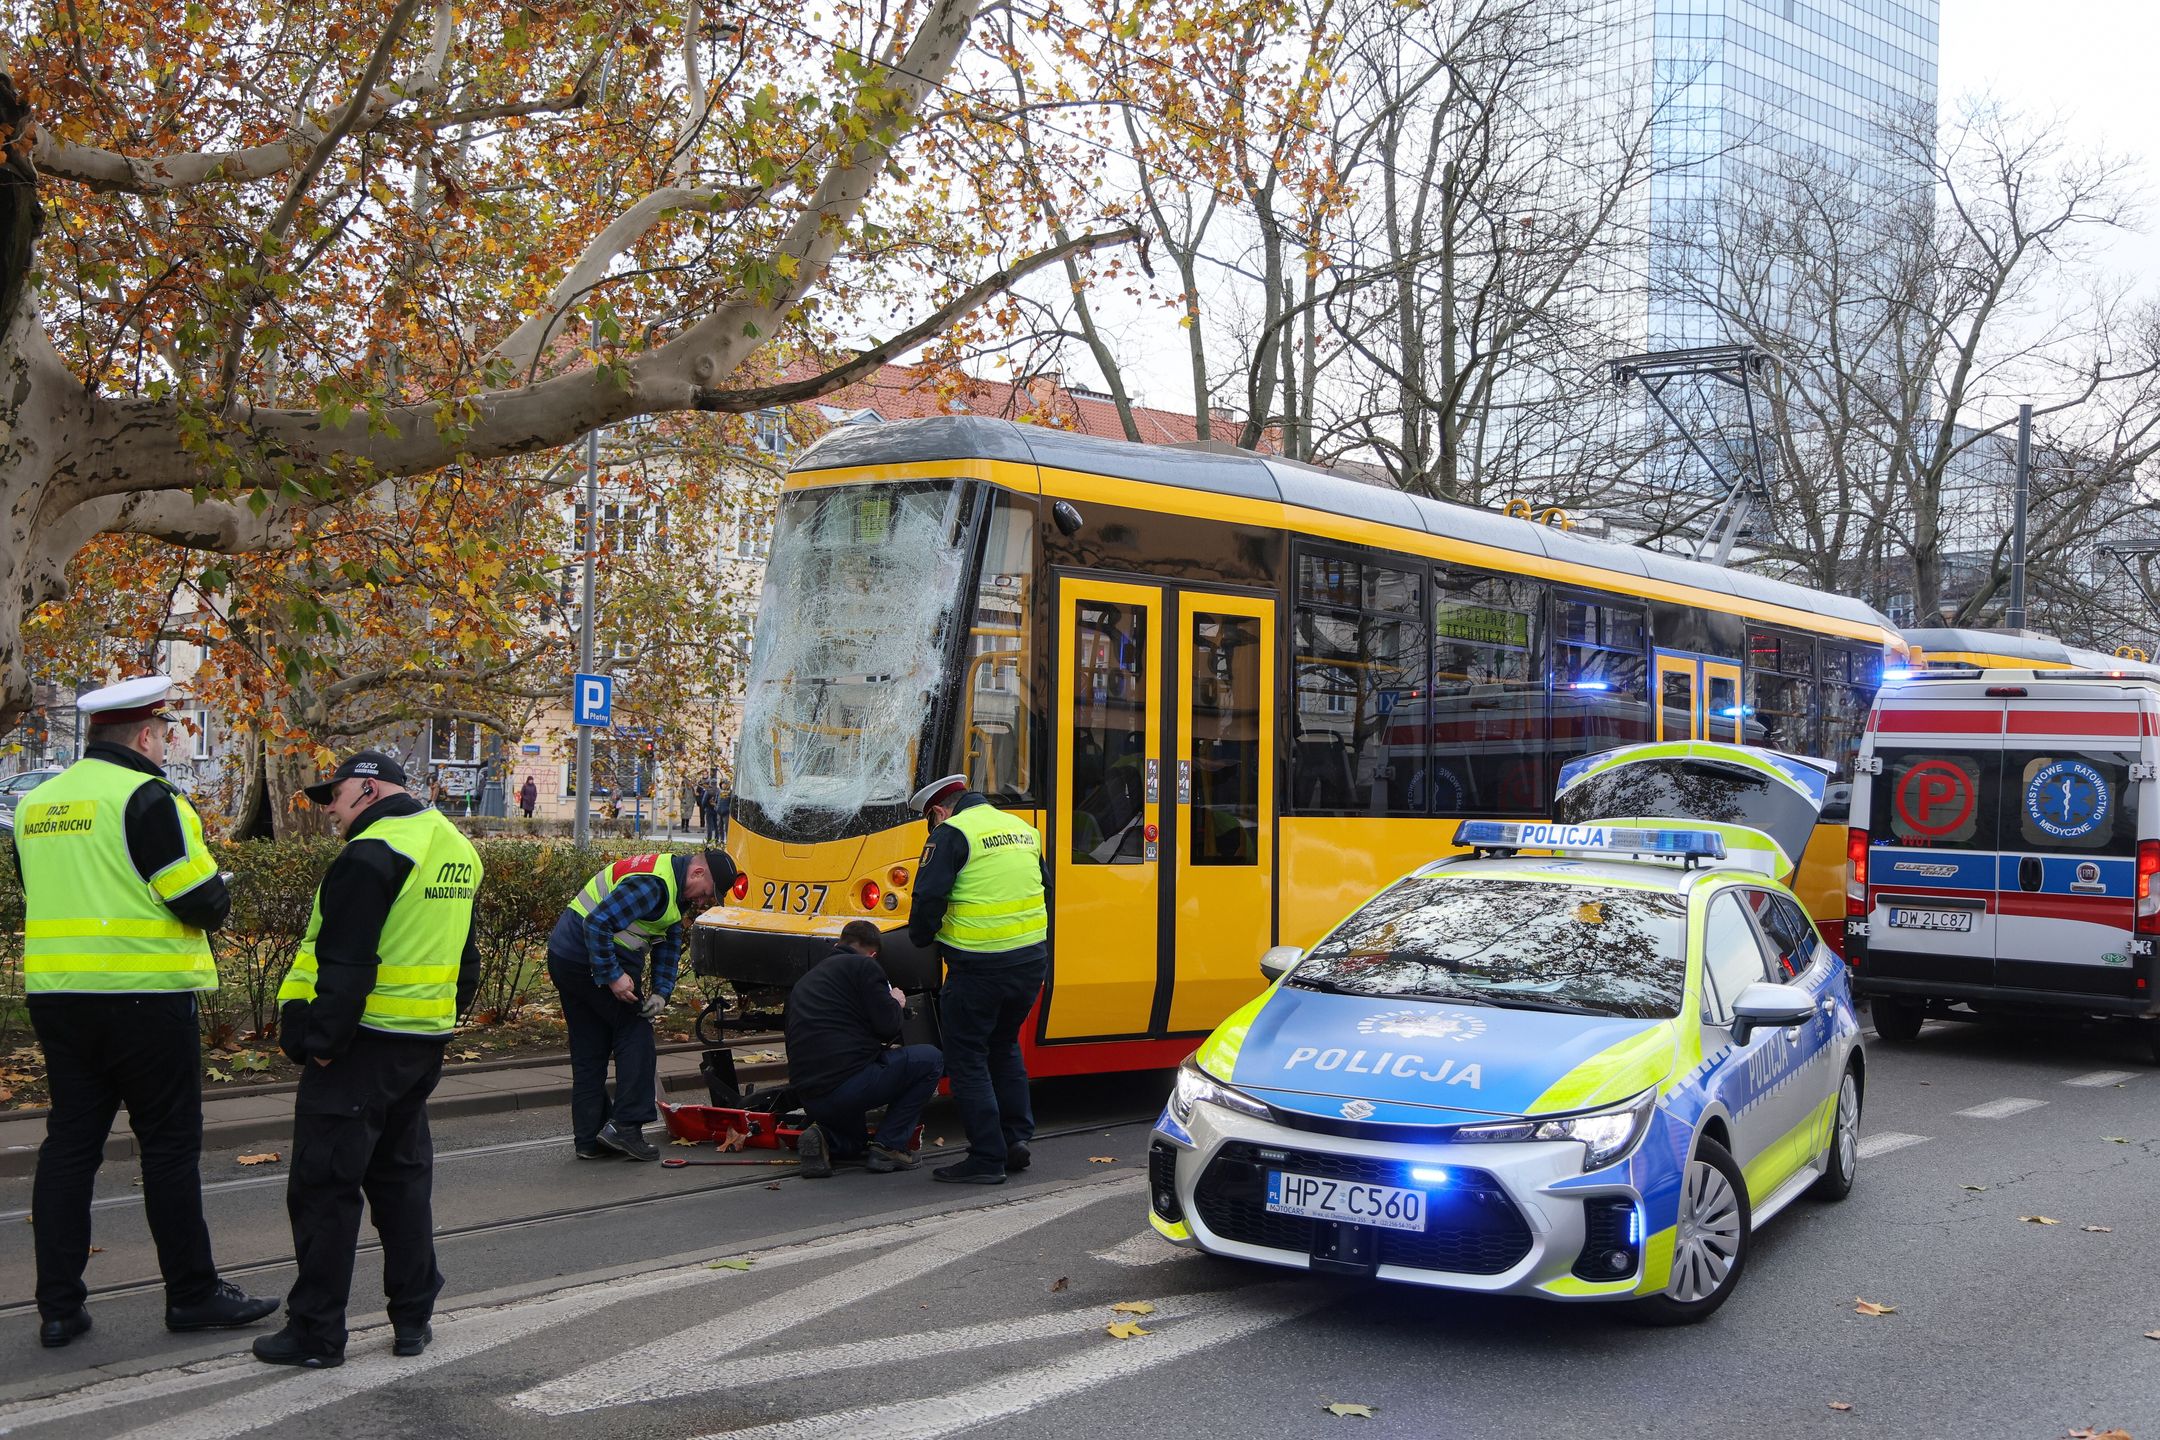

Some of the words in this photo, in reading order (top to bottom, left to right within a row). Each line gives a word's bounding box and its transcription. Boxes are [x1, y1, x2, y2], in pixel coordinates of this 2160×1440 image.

[583, 680, 604, 719] P
[1918, 774, 1956, 820] P
[2027, 764, 2063, 818] PAŃSTWOWE
[2074, 764, 2107, 820] RATOWNICTWO
[24, 819, 57, 835] NADZÓR
[58, 819, 92, 832] RUCHU
[1521, 825, 1604, 846] POLICJA
[2039, 819, 2092, 836] MEDYCZNE
[761, 881, 829, 916] 2137
[1900, 911, 1918, 924] DW
[1923, 913, 1967, 927] 2LC87
[1283, 1048, 1481, 1089] POLICJA
[1748, 1029, 1788, 1095] POLICJA
[1269, 1191, 1278, 1200] PL
[1269, 1204, 1305, 1215] MOTOCARS
[1285, 1176, 1338, 1211] HPZ
[1348, 1186, 1419, 1222] C560
